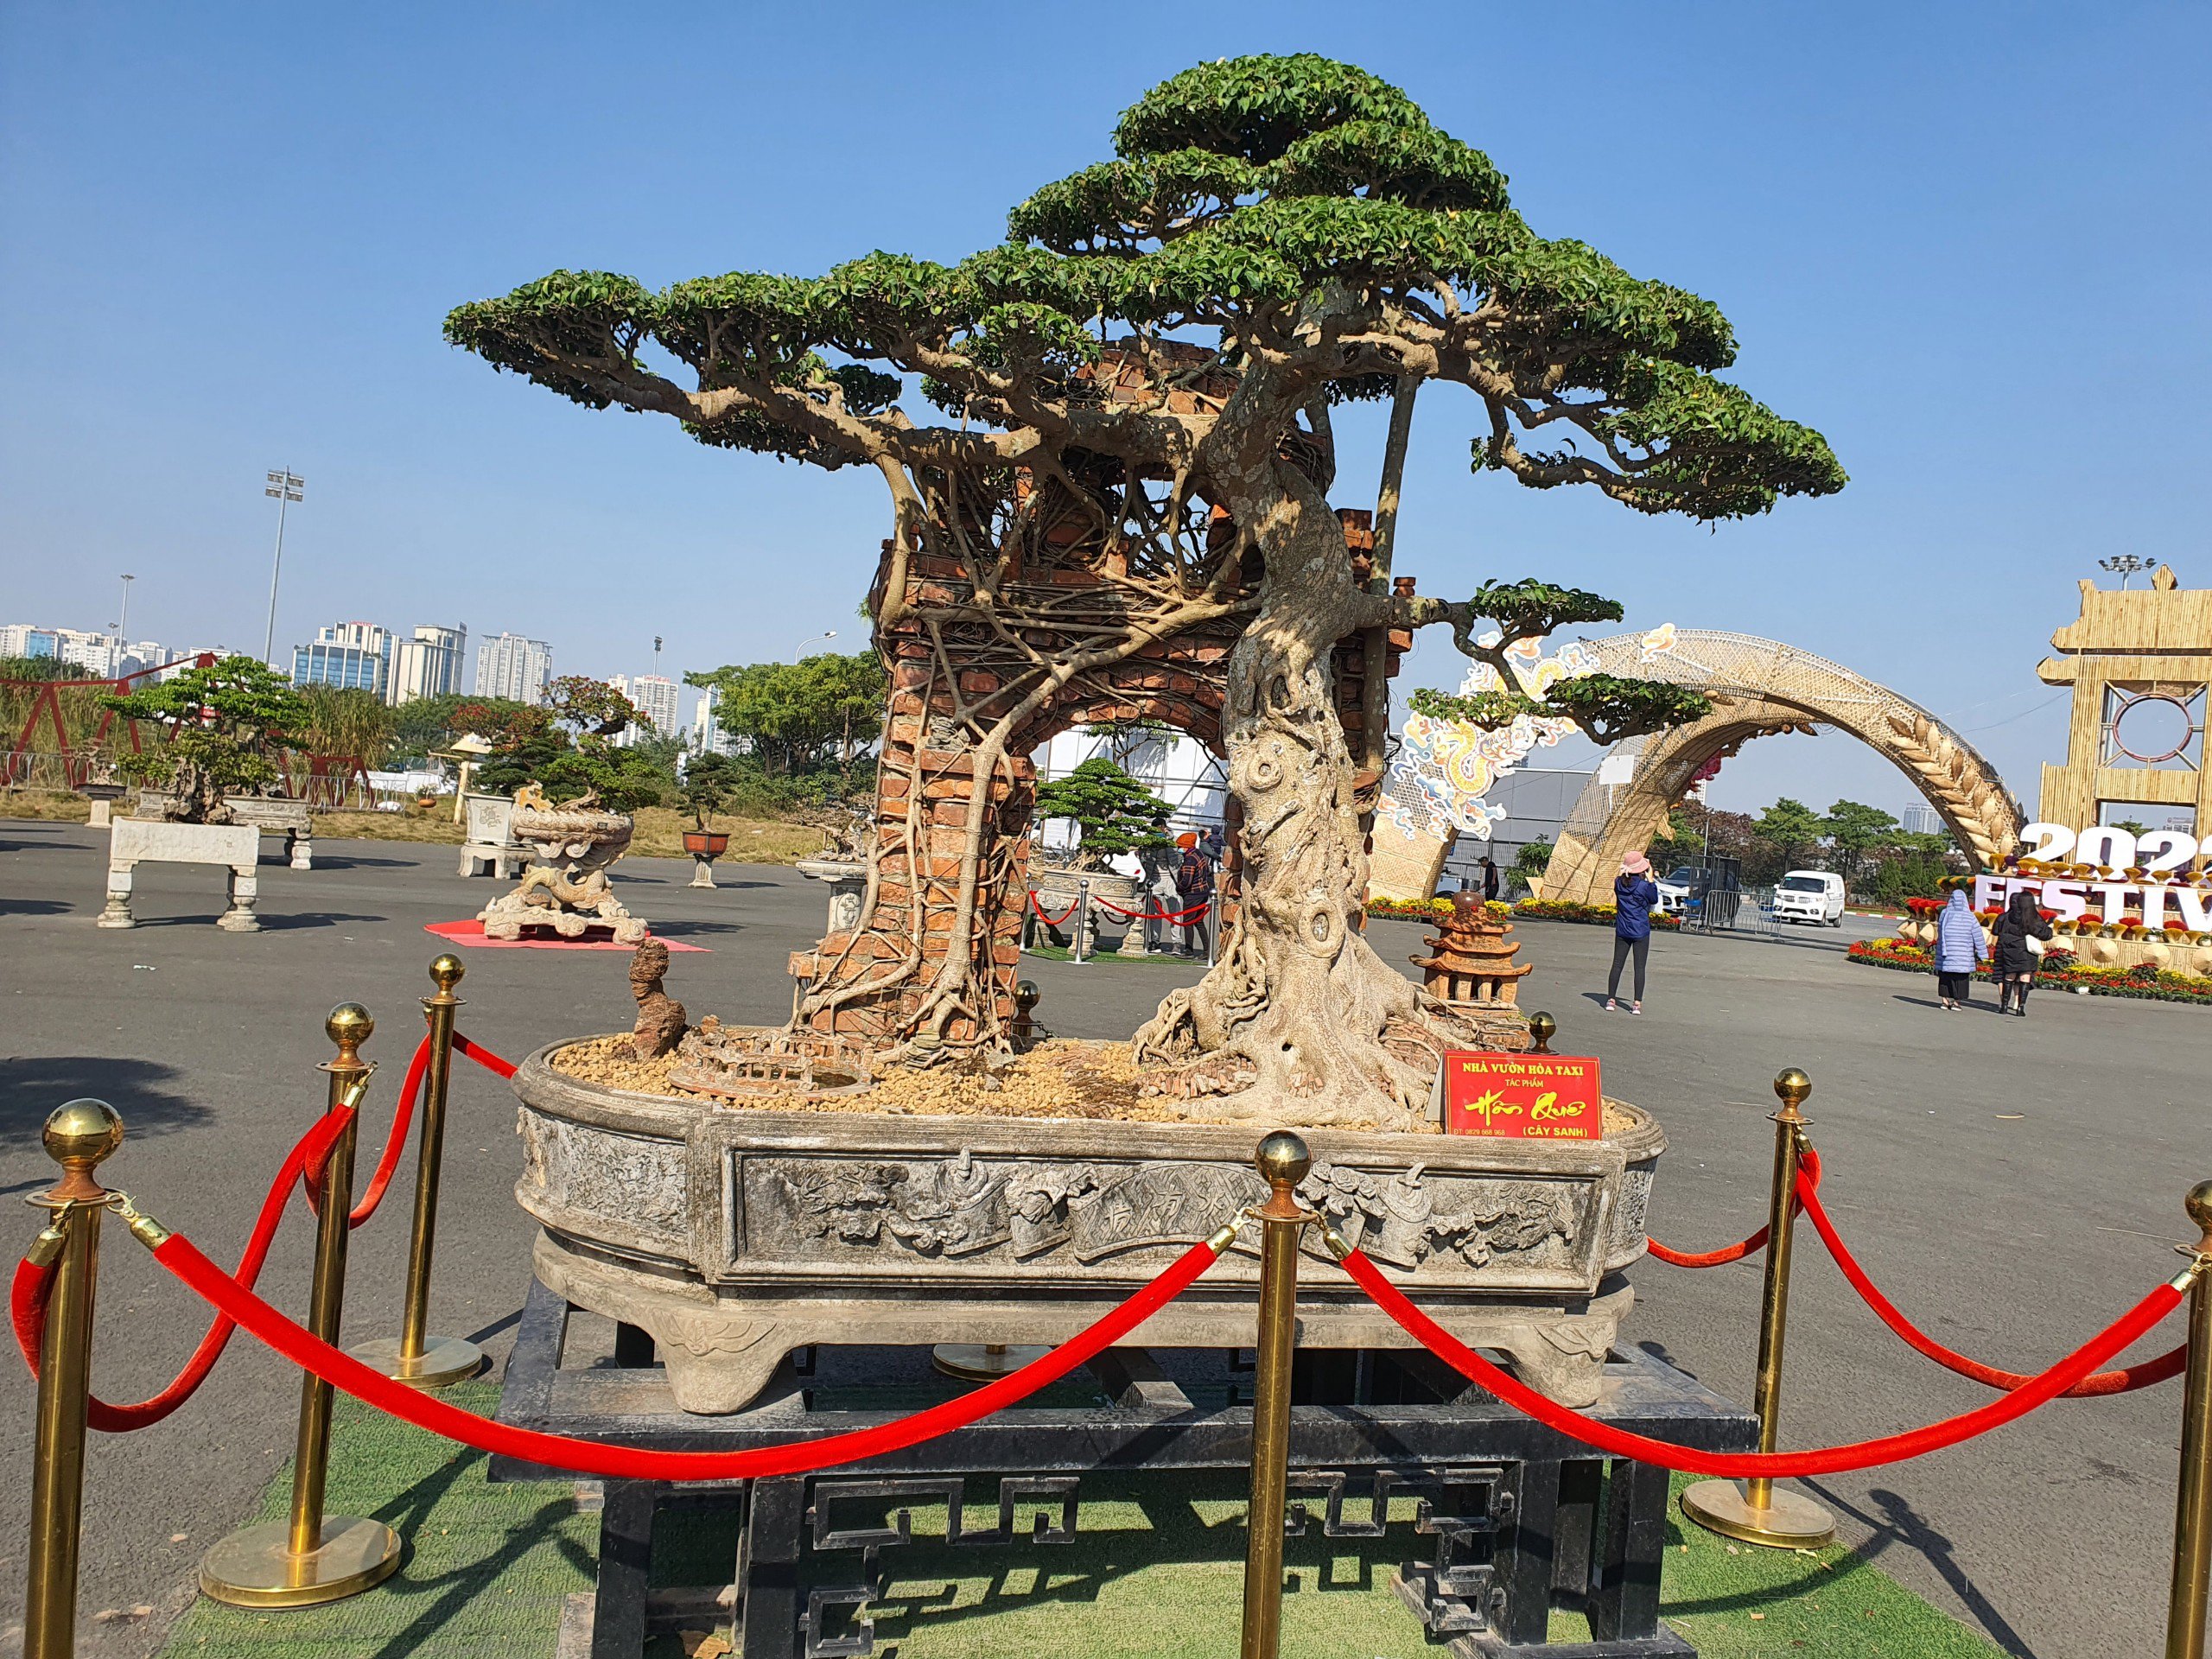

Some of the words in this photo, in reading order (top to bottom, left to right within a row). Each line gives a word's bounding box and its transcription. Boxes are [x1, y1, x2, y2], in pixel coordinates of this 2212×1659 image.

[1463, 1060, 1489, 1073] NHÀ
[1491, 1062, 1525, 1074] VƯỜN
[1528, 1063, 1554, 1075] HÒA
[1555, 1065, 1584, 1077] TAXI
[1504, 1077, 1521, 1087] TÁC
[1522, 1077, 1544, 1088] PHẨM
[1522, 1125, 1550, 1135] (CÂY
[1553, 1128, 1588, 1138] SANH)
